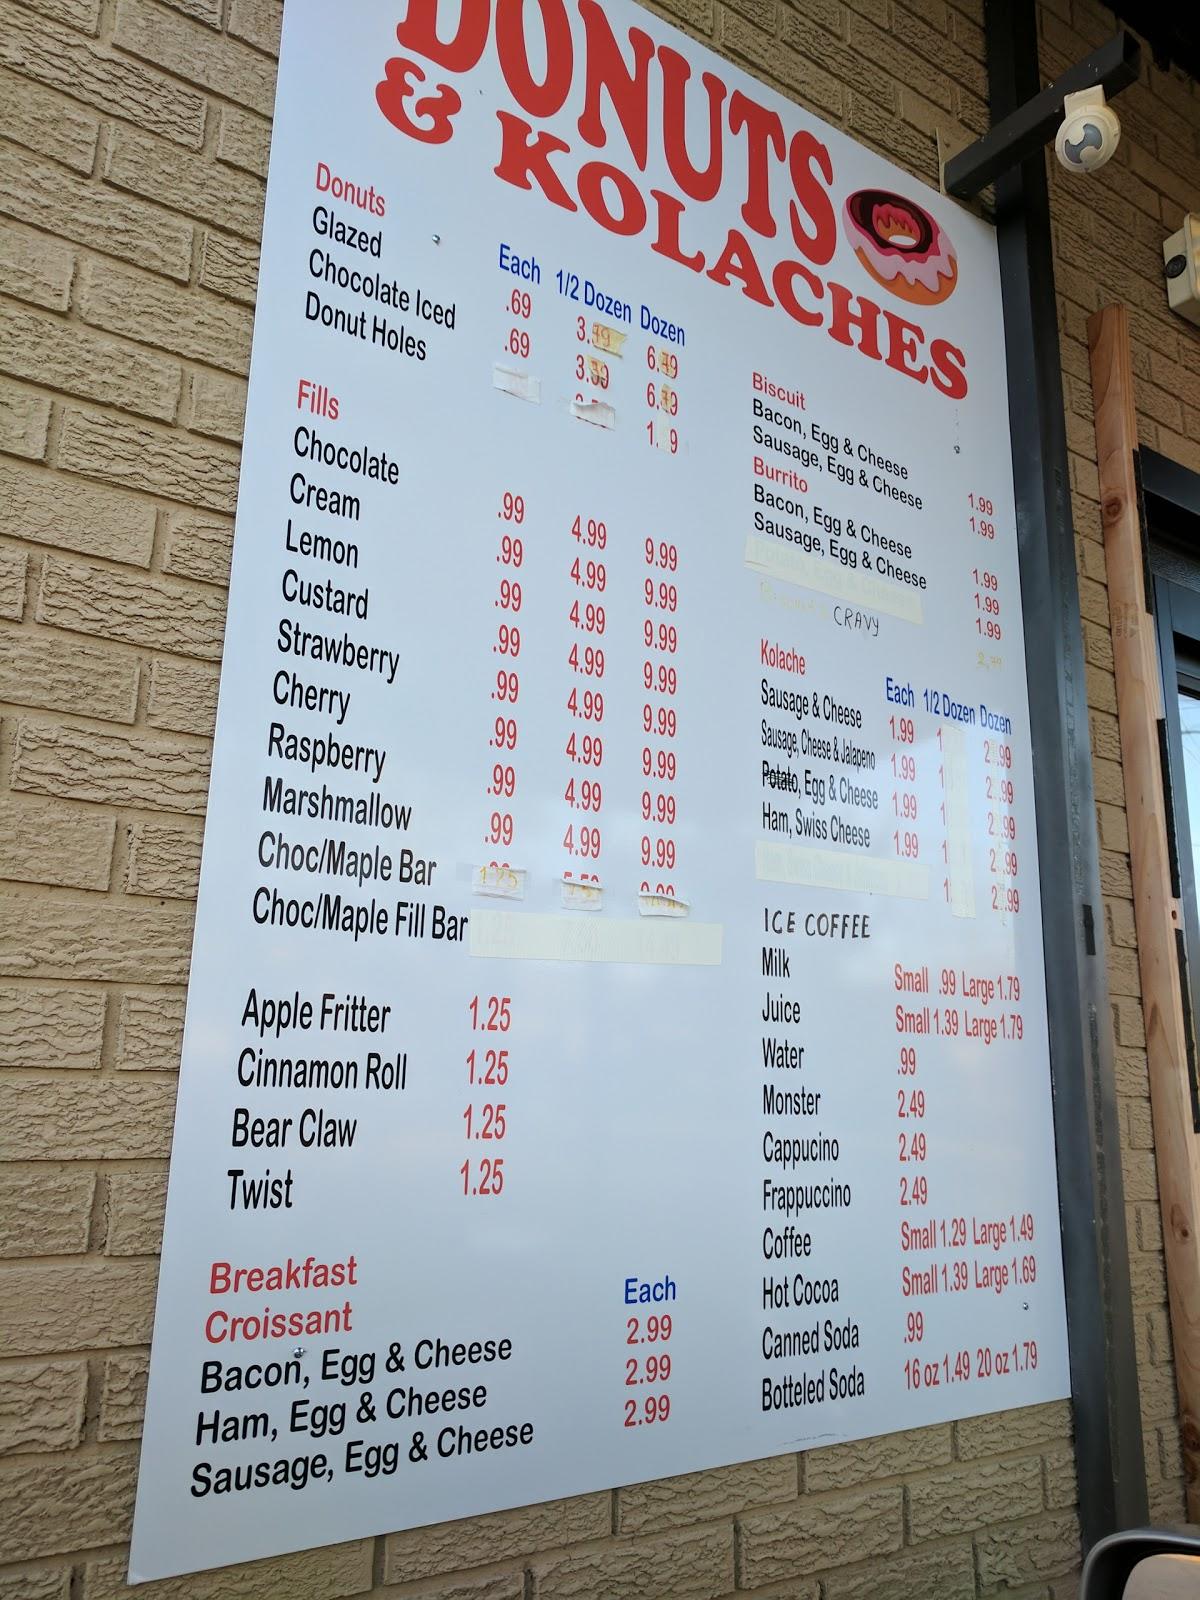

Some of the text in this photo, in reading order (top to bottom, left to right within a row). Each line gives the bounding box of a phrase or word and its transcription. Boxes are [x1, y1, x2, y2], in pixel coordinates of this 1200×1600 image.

[315, 161, 385, 217] Donuts
[312, 205, 382, 258] Glazed
[375, 57, 969, 399] & KOLACHES
[309, 248, 455, 330] Chocolate Iced
[499, 242, 685, 347] Each 1/2 Dozen Dozen
[505, 288, 531, 319] .69
[305, 290, 426, 361] Donut Holes
[504, 327, 530, 358] .69
[297, 378, 339, 420] Fills
[752, 371, 805, 410] Biscuit
[293, 425, 399, 485] Chocolate
[752, 397, 908, 480] Bacon, Egg Cheese
[752, 455, 808, 493] Burrito
[753, 424, 922, 510] Sausage, Egg Cheese
[289, 472, 360, 521] Cream
[497, 491, 524, 524] .99
[967, 492, 993, 516] 1.99
[571, 514, 607, 550] 4.99
[754, 482, 911, 559] Bacon, Egg Cheese
[968, 515, 994, 539] 1.99
[285, 518, 358, 568] Lemon
[496, 534, 523, 568] .99
[644, 536, 677, 572] 9.99
[754, 511, 824, 556] Sausage,
[829, 538, 857, 568] Egg
[875, 556, 926, 589] Cheese
[570, 556, 606, 592] 4.99
[972, 567, 997, 591] 1.99
[281, 568, 368, 620] Custard
[494, 578, 521, 612] .99
[644, 577, 677, 612] 9.99
[568, 599, 605, 635] 4.99
[644, 618, 677, 653] 9.99
[277, 618, 399, 684] Strawberry
[760, 638, 805, 675] Kolache
[272, 669, 350, 725] Cherry
[490, 669, 519, 703] .99
[566, 687, 603, 722] 4.99
[760, 677, 861, 729] Sausage Cheese
[643, 703, 676, 737] 9.99
[885, 676, 1011, 735] Each 1/2 Dozen Dozen
[488, 716, 517, 750] .99
[761, 718, 875, 772] Sausage, Cheese Jalapeno
[889, 714, 914, 744] 1.99
[267, 721, 386, 783] Raspberry
[565, 731, 602, 767] 4.99
[642, 746, 676, 781] 9.99
[262, 775, 412, 830] Marshmallow
[564, 777, 601, 812] 4.99
[804, 768, 878, 809] Egg Cheese
[484, 811, 513, 846] .99
[563, 823, 600, 858] 4.99
[762, 800, 870, 848] Ham, Swiss Cheese
[257, 830, 392, 887] Choc/Maple
[398, 848, 436, 886] Bar
[641, 835, 675, 869] 9.99
[252, 886, 388, 942] Choc/Maple
[395, 901, 425, 938] Fill
[431, 904, 468, 941] Bar
[764, 907, 870, 939] ICE COFFEE
[761, 946, 790, 978] Milk
[894, 962, 1020, 1005] Small .99 Large 1.79
[241, 987, 391, 1038] Apple Fritter
[469, 995, 510, 1031] 1.25
[761, 991, 800, 1023] Juice
[895, 1004, 1023, 1045] Small 1.39 Large 1.79
[237, 1047, 407, 1090] Cinnamon Roll
[466, 1049, 508, 1085] 1.25
[761, 1037, 804, 1069] Water
[897, 1046, 916, 1075] .99
[762, 1084, 820, 1115] Monster
[897, 1089, 925, 1118] 2.49
[231, 1107, 357, 1147] Bear Claw
[463, 1103, 506, 1139] 1.25
[762, 1130, 839, 1170] Cappucino
[898, 1132, 926, 1162] 2.49
[226, 1168, 293, 1210] Twist
[460, 1158, 503, 1195] 1.25
[899, 1175, 927, 1205] 2.49
[763, 1176, 851, 1218] Frappuccino
[762, 1225, 811, 1259] Coffee
[900, 1213, 1033, 1251] Small 1.29 Large 1.49
[209, 1255, 357, 1294] Breakfast
[624, 1274, 676, 1304] Each
[762, 1273, 839, 1310] Hot Cocoa
[901, 1254, 1036, 1296] Small 1.39 Large 1.69
[205, 1301, 352, 1343] Croissant
[626, 1314, 672, 1344] 2.99
[761, 1316, 859, 1360] Canned Soda
[903, 1311, 924, 1343] .99
[200, 1337, 512, 1394] Bacon, Egg & Cheese
[625, 1353, 670, 1385] 2.99
[904, 1340, 1037, 1390] 16 1.49 20 1.79
[761, 1364, 864, 1411] Botteled Soda
[195, 1385, 486, 1446] Ham, Egg & Cheese
[623, 1394, 670, 1427] 2.99
[190, 1422, 533, 1497] Sausage, Egg & Cheese
